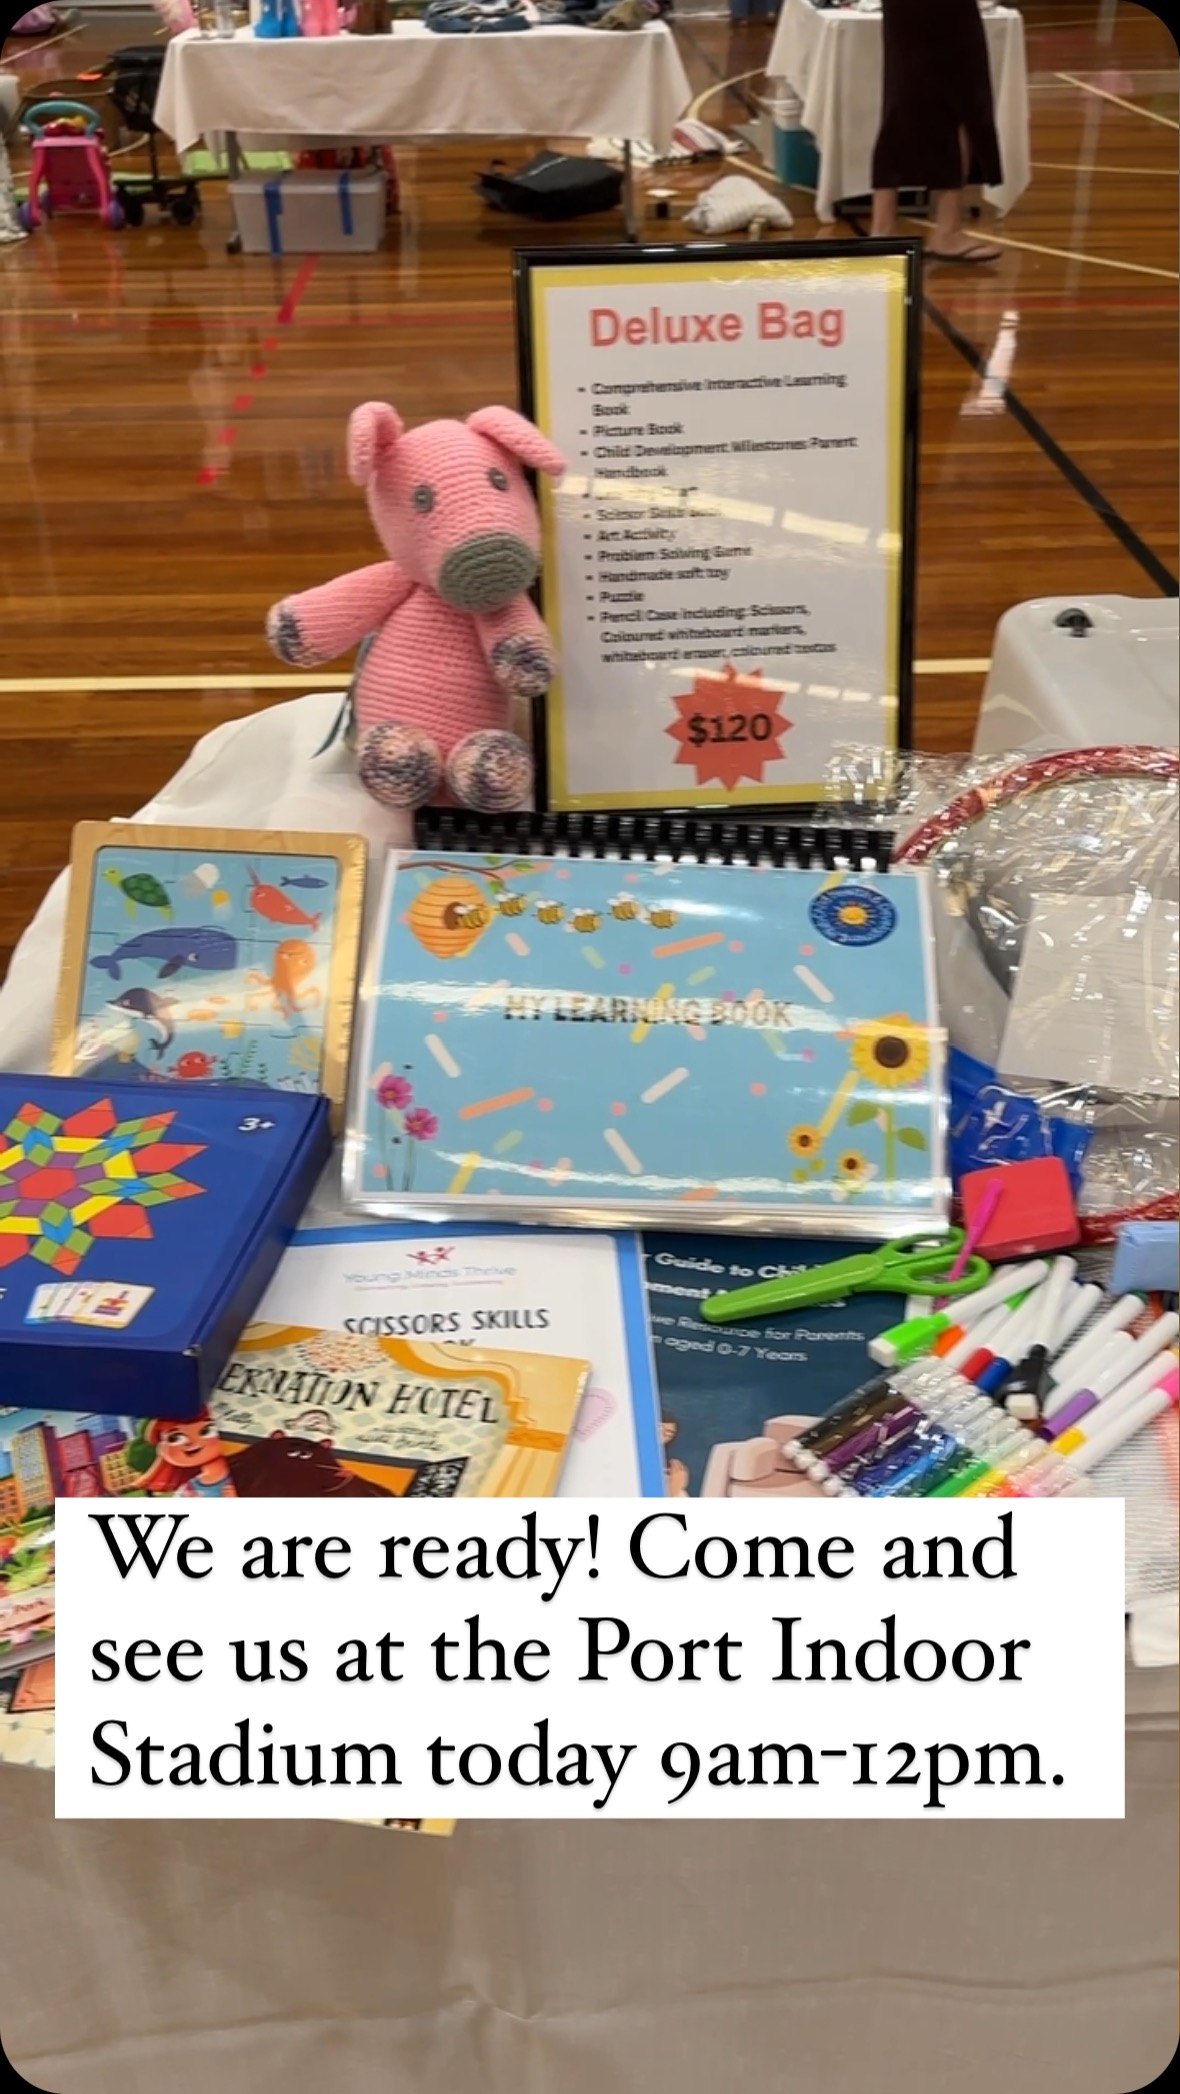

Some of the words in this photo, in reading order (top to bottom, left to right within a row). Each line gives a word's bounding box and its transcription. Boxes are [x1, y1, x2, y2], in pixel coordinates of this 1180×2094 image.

[589, 307, 743, 347] Deluxe
[757, 301, 845, 348] Bag
[591, 379, 702, 396] Comprehensive
[705, 376, 781, 391] Interactive
[783, 373, 847, 389] Learning
[591, 403, 630, 417] Book
[593, 425, 644, 437] Picture
[647, 423, 684, 436] Book
[593, 445, 631, 458] Child
[634, 442, 728, 457] Development
[730, 439, 807, 452] Milestones
[809, 436, 859, 449] Parent
[595, 466, 668, 479] Handbook
[598, 550, 655, 562] Problem
[659, 548, 711, 562] Solving
[713, 545, 753, 558] Game
[599, 570, 673, 582] Handmade
[676, 567, 704, 579] soft
[705, 568, 731, 580] toy
[600, 590, 645, 603] Puzzle
[601, 610, 642, 623] Pencil
[646, 609, 678, 621] Case
[751, 604, 811, 617] Scissors,
[601, 630, 664, 643] Coloured
[668, 627, 745, 641] whiteboard
[601, 649, 679, 663] whiteboard
[731, 643, 792, 657] coloured
[687, 711, 773, 748] $120
[504, 995, 545, 1020] MY
[553, 997, 701, 1026] LEARNING
[710, 1000, 797, 1027] BOOK
[237, 1116, 275, 1131] 3+
[343, 1272, 400, 1284] Young
[404, 1268, 459, 1280] Minds
[463, 1266, 517, 1276] Thrive
[654, 1253, 725, 1274] Guide
[729, 1264, 754, 1277] to
[343, 1312, 461, 1336] SCISSORS
[472, 1308, 550, 1331] SKILLS
[677, 1316, 761, 1338] Resource
[765, 1327, 792, 1340] for
[794, 1328, 865, 1341] Parents
[664, 1337, 716, 1352] aged
[717, 1342, 751, 1357] 0-7
[753, 1347, 808, 1361] Years
[386, 1383, 499, 1424] HOTEL
